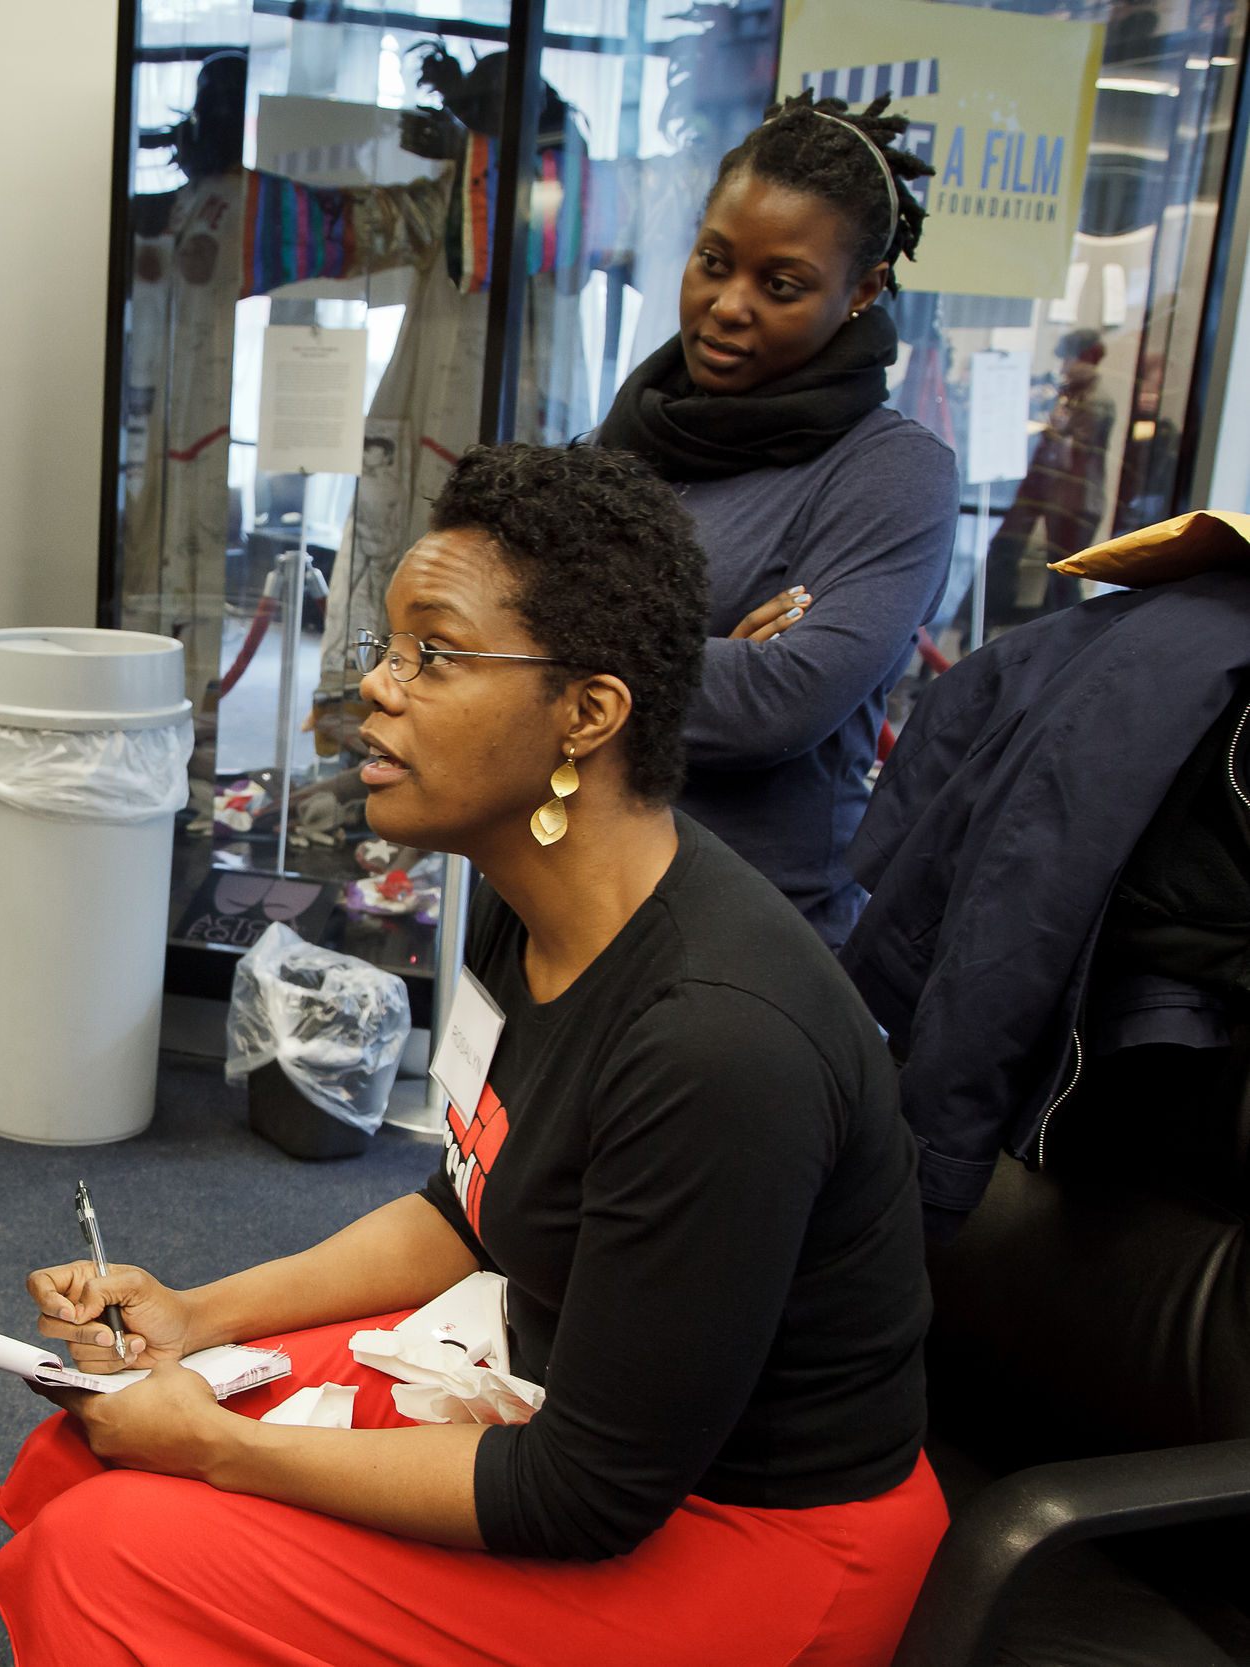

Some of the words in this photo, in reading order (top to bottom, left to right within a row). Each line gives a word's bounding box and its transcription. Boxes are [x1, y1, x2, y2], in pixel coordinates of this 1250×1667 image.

[942, 125, 965, 188] A
[981, 130, 1064, 195] FILM
[937, 192, 1056, 221] FOUNDATION
